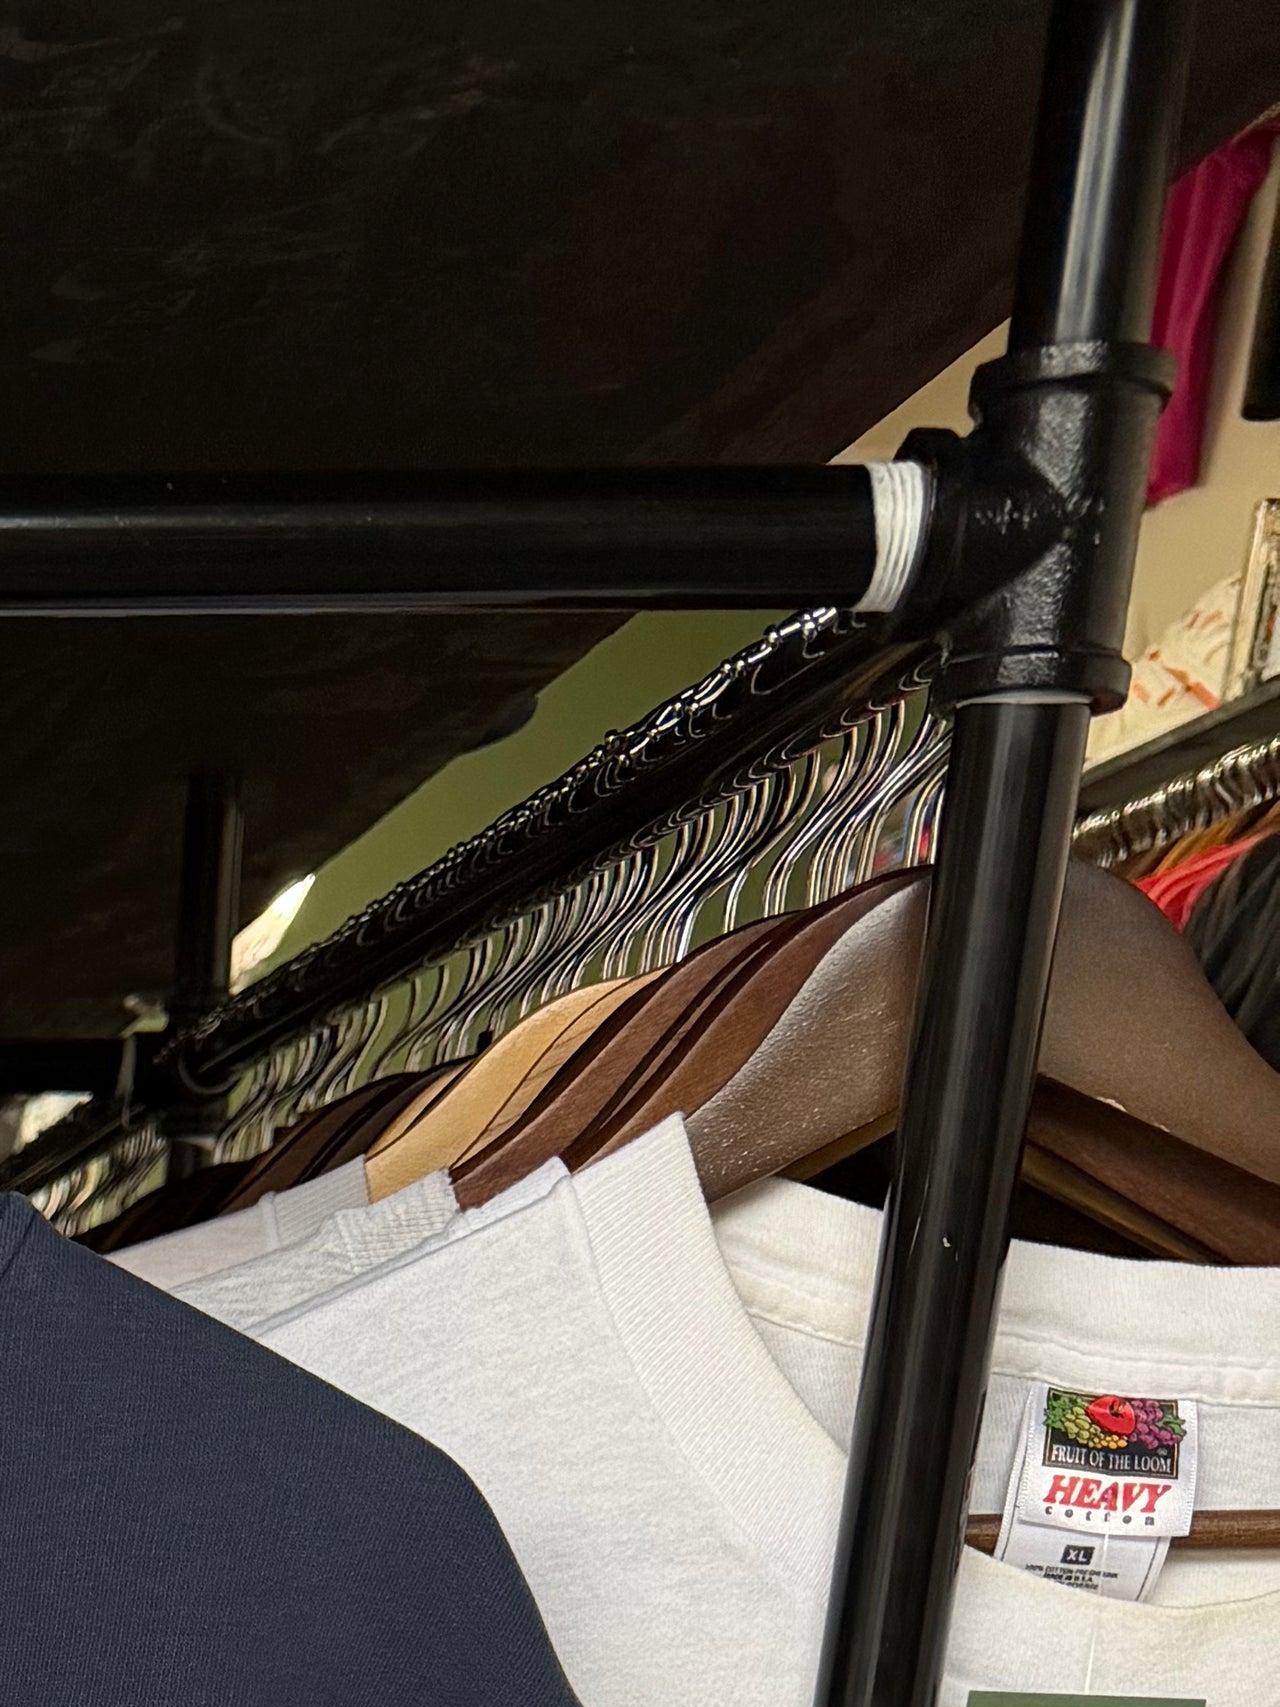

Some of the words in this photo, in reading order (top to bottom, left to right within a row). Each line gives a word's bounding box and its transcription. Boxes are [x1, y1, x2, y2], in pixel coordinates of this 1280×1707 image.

[1051, 1444, 1086, 1466] FRUIT
[1090, 1450, 1105, 1468] OF
[1109, 1453, 1131, 1471] THE
[1133, 1454, 1172, 1473] LOOM
[1042, 1474, 1173, 1513] HEAVY
[1066, 1548, 1088, 1562] XL
